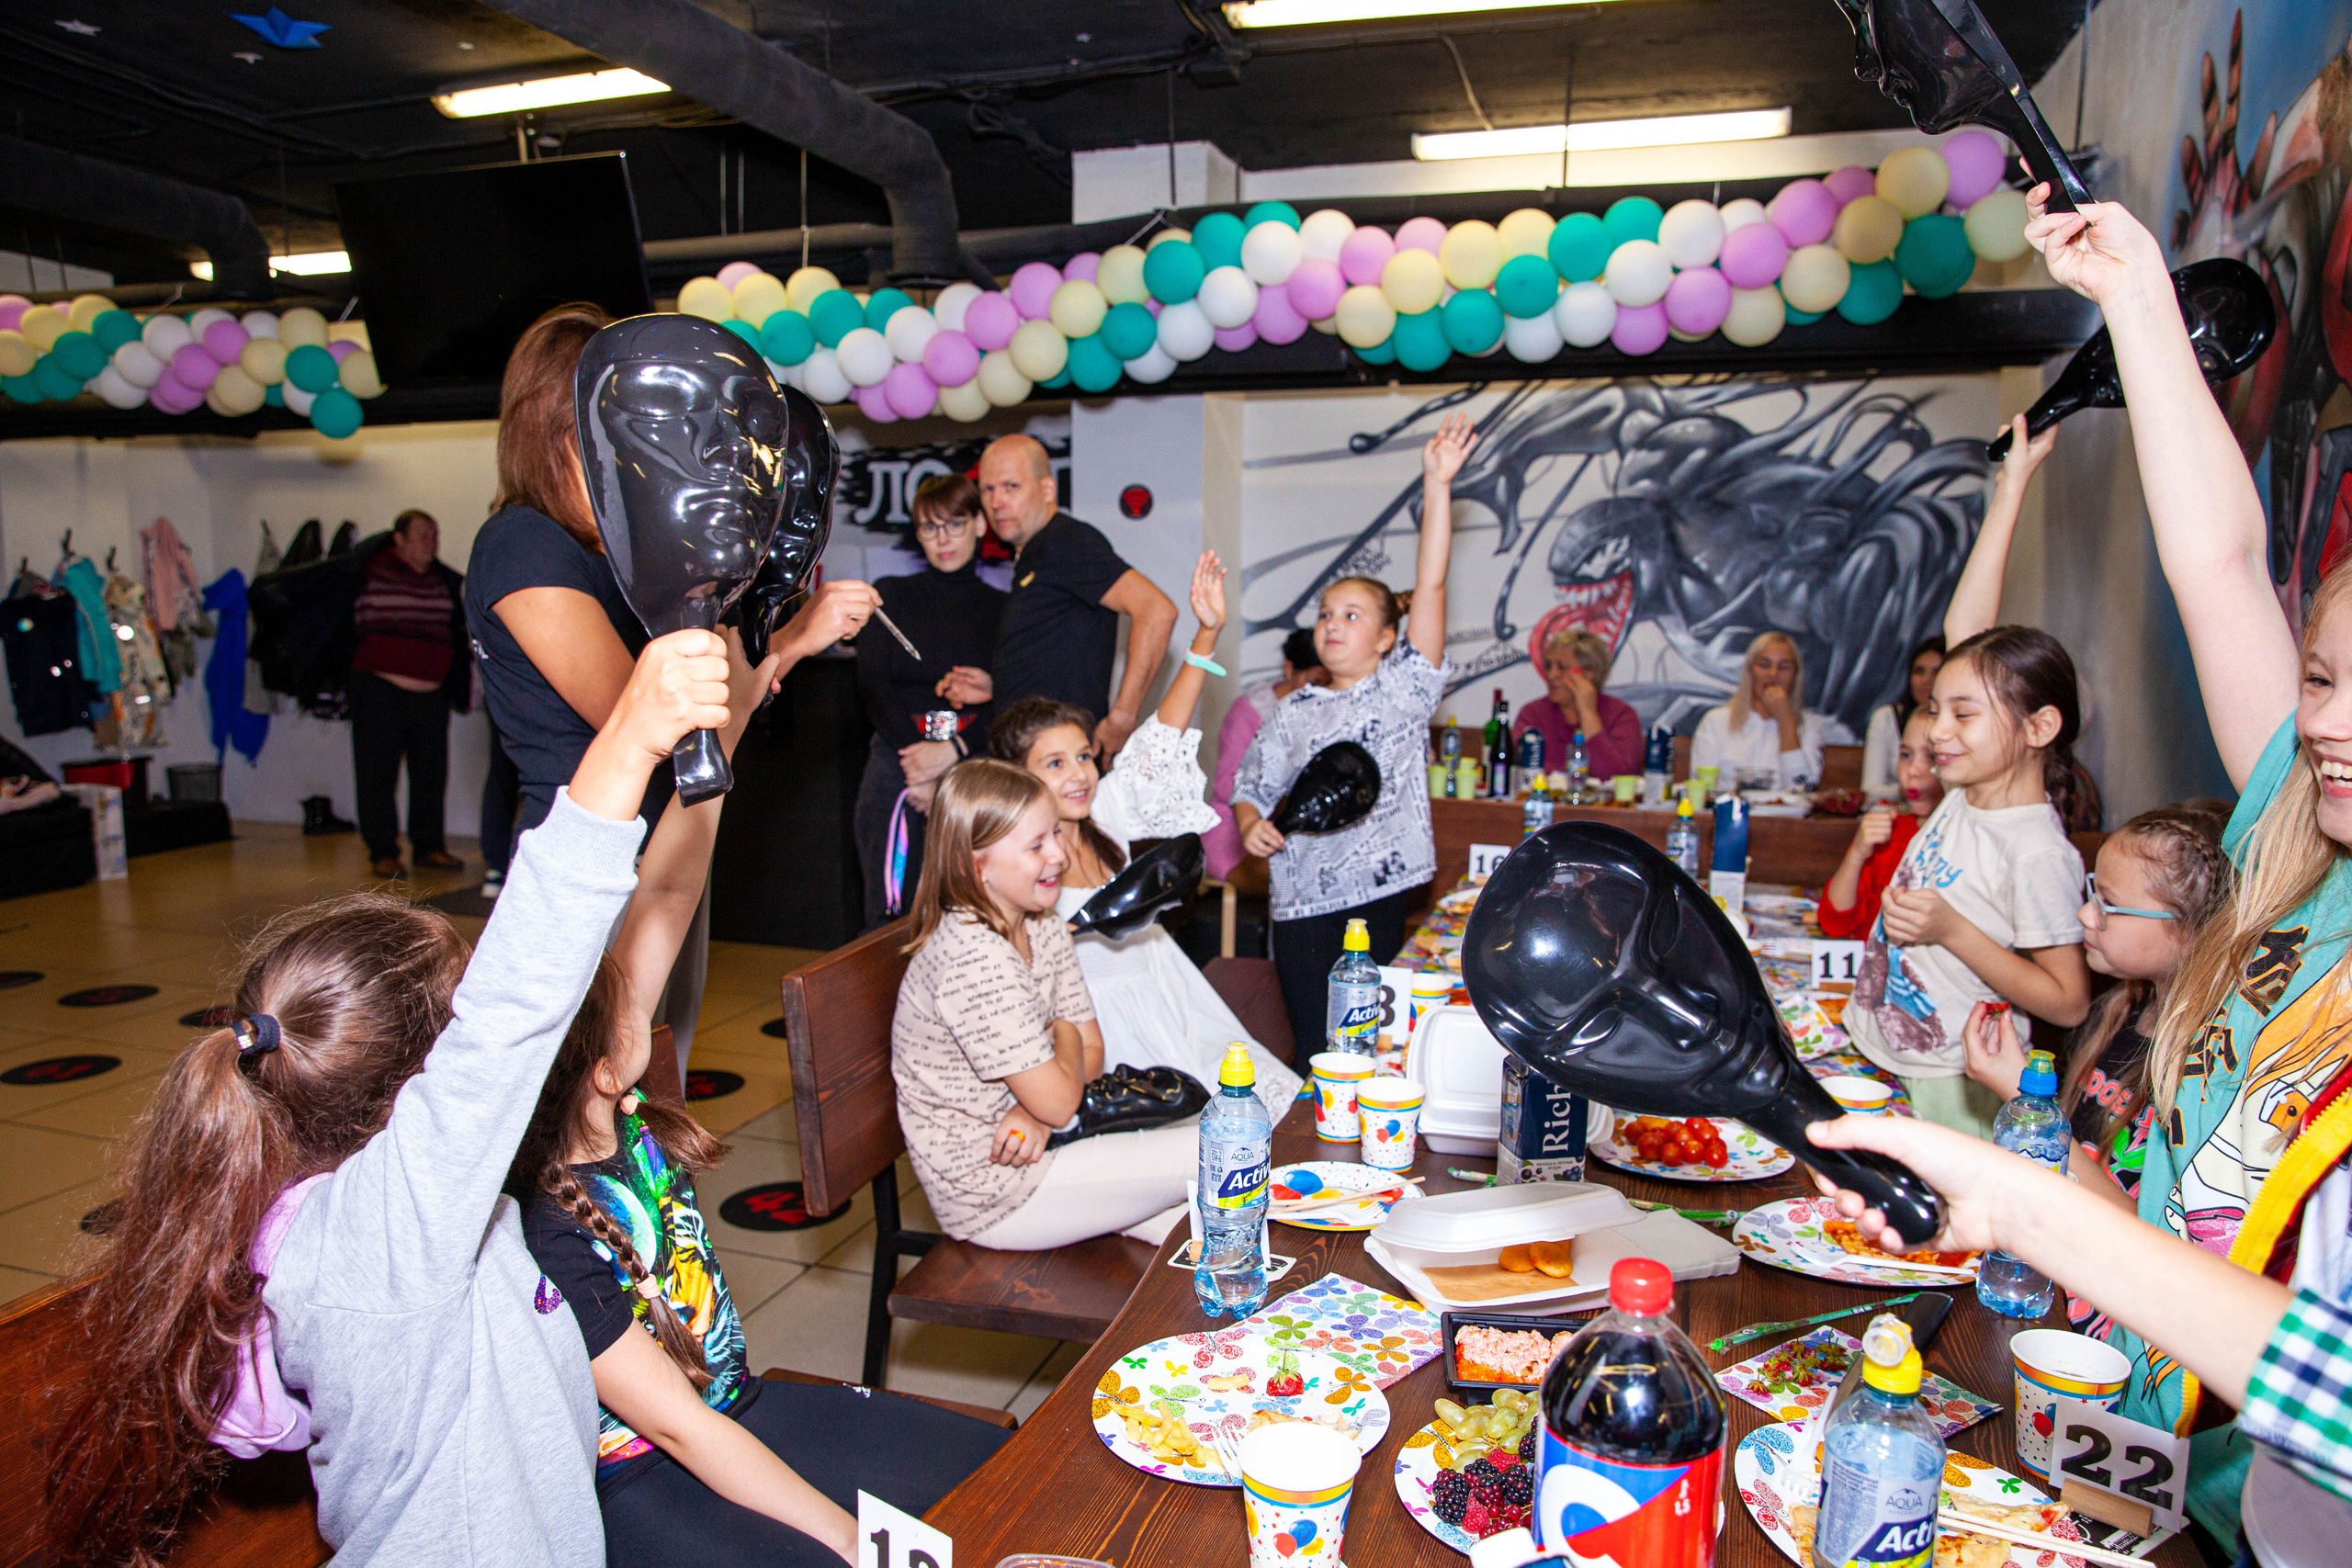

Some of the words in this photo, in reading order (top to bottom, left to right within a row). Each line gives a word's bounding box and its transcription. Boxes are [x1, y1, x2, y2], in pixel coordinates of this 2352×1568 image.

[1819, 952, 1858, 978] 11
[1231, 1152, 1254, 1161] AQUA
[2061, 1424, 2174, 1511] 22
[1885, 1495, 1923, 1510] AQUA
